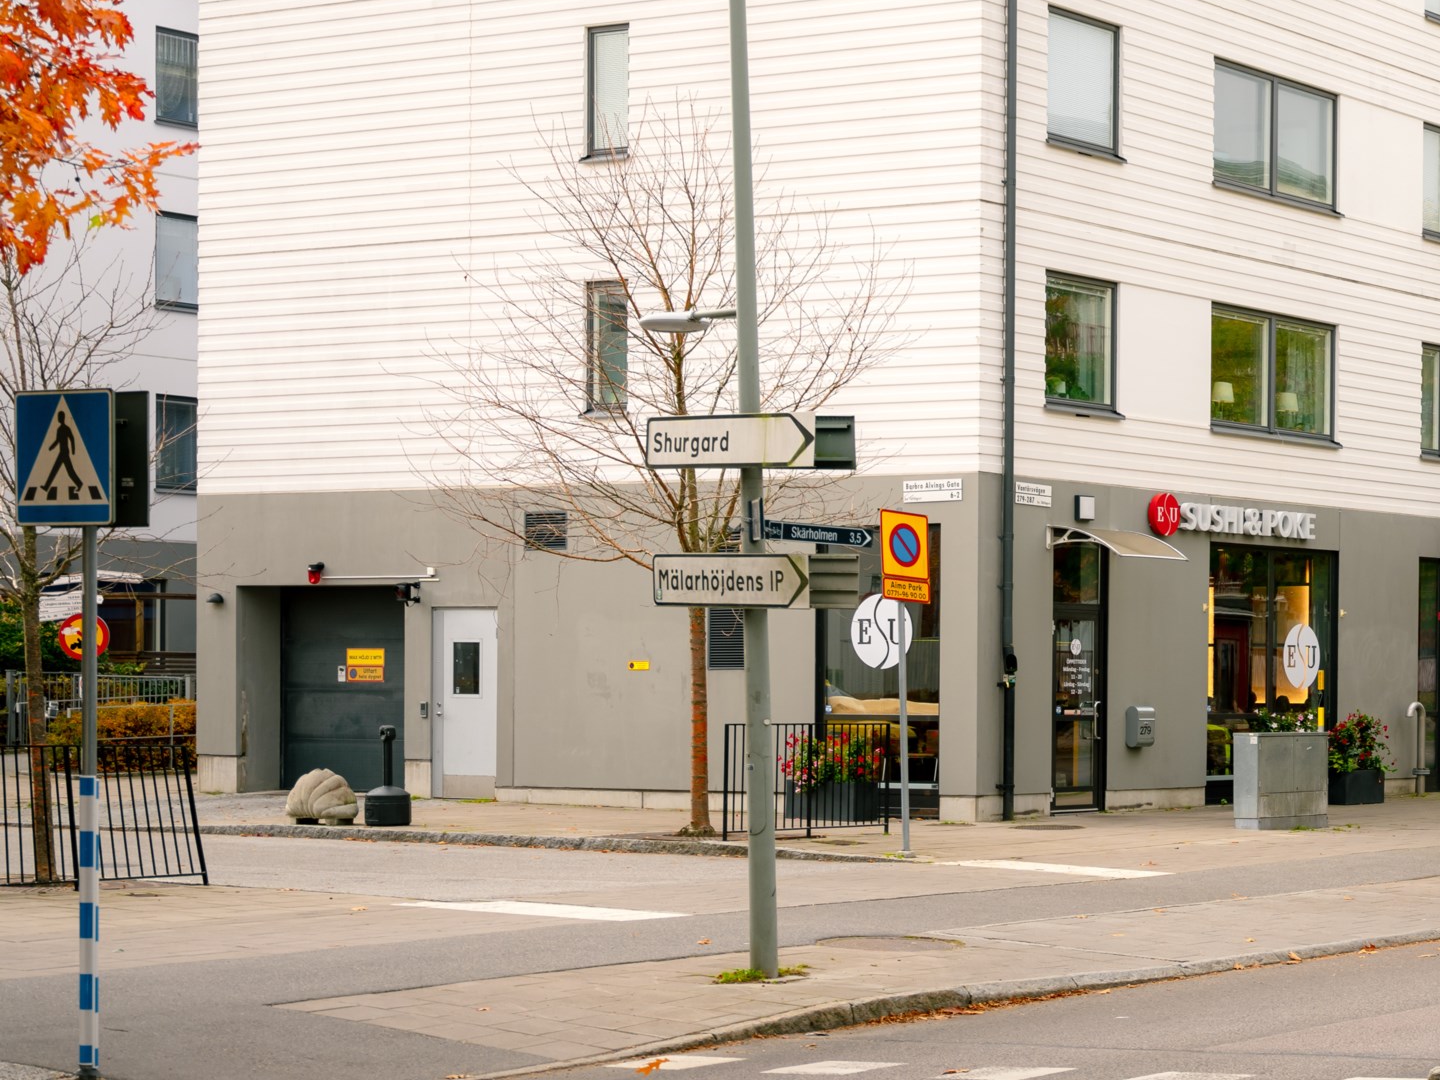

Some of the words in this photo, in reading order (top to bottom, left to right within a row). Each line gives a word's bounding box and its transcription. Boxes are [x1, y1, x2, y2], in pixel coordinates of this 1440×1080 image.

[653, 430, 729, 457] Shurgard
[905, 482, 923, 490] Barbro
[925, 481, 945, 490] Alvings
[946, 480, 960, 488] Gata
[1180, 502, 1244, 534] SUSHI
[1262, 509, 1317, 540] POKE
[790, 526, 838, 541] Skärholmen
[849, 532, 862, 544] 3,5
[658, 569, 764, 596] Mälarhöjdens
[770, 570, 784, 592] IP
[890, 581, 907, 590] Aimo
[908, 583, 922, 592] Park
[909, 591, 918, 599] 90
[1139, 725, 1152, 735] 279
